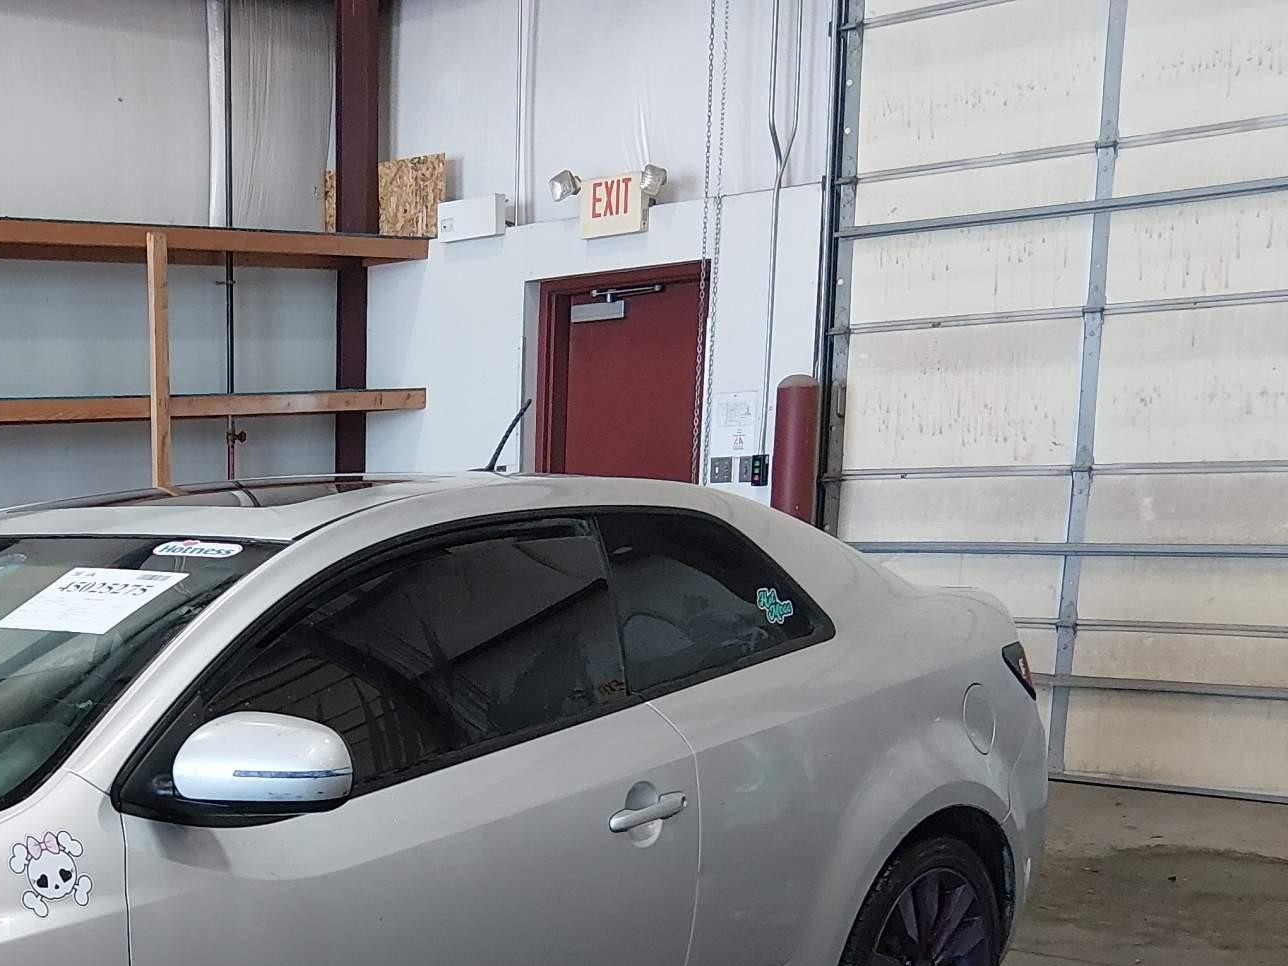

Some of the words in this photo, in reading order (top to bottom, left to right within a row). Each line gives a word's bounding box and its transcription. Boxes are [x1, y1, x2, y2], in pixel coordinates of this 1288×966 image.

[592, 177, 632, 218] EXIT
[158, 544, 235, 556] Hotness
[58, 581, 155, 597] 45025275
